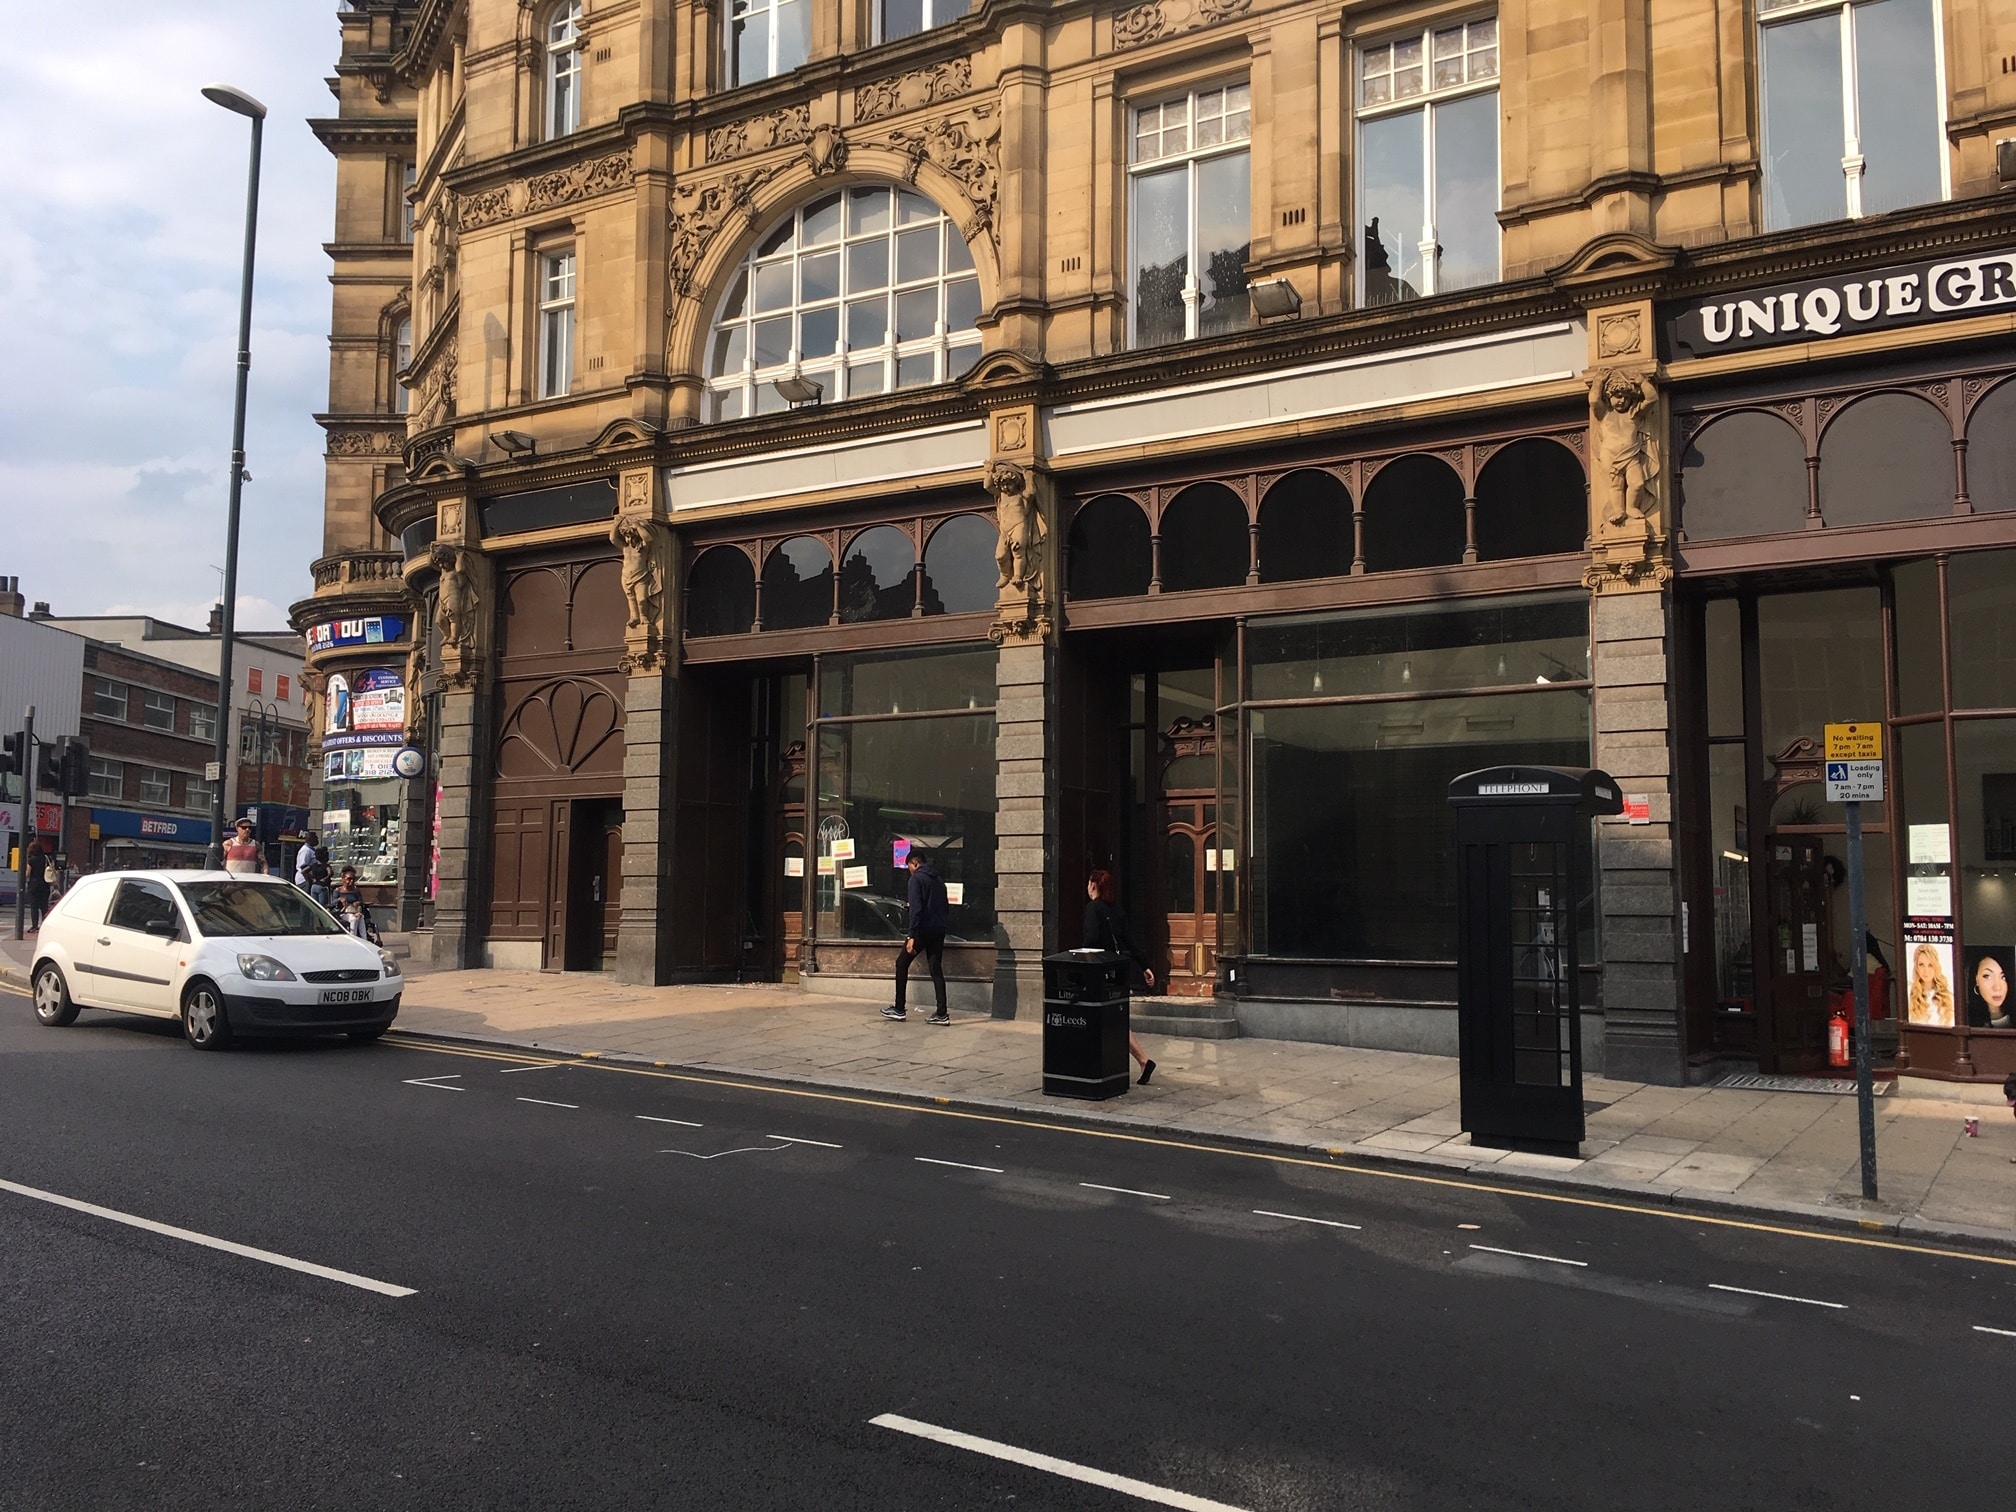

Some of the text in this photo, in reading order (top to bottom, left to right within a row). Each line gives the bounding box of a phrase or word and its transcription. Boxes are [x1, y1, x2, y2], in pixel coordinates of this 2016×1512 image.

[1699, 273, 1922, 343] UNIQUE
[333, 619, 364, 640] YOU
[336, 735, 356, 745] OFFERS
[362, 734, 403, 743] DISCOUNTS
[1846, 734, 1874, 742] waiting
[1850, 764, 1880, 772] Loading
[1856, 771, 1874, 779] only
[1482, 783, 1545, 794] TELEPHONE
[142, 820, 178, 835] BETFRED
[322, 990, 371, 1003] NC08 OBK
[1062, 1016, 1087, 1025] Leeds
